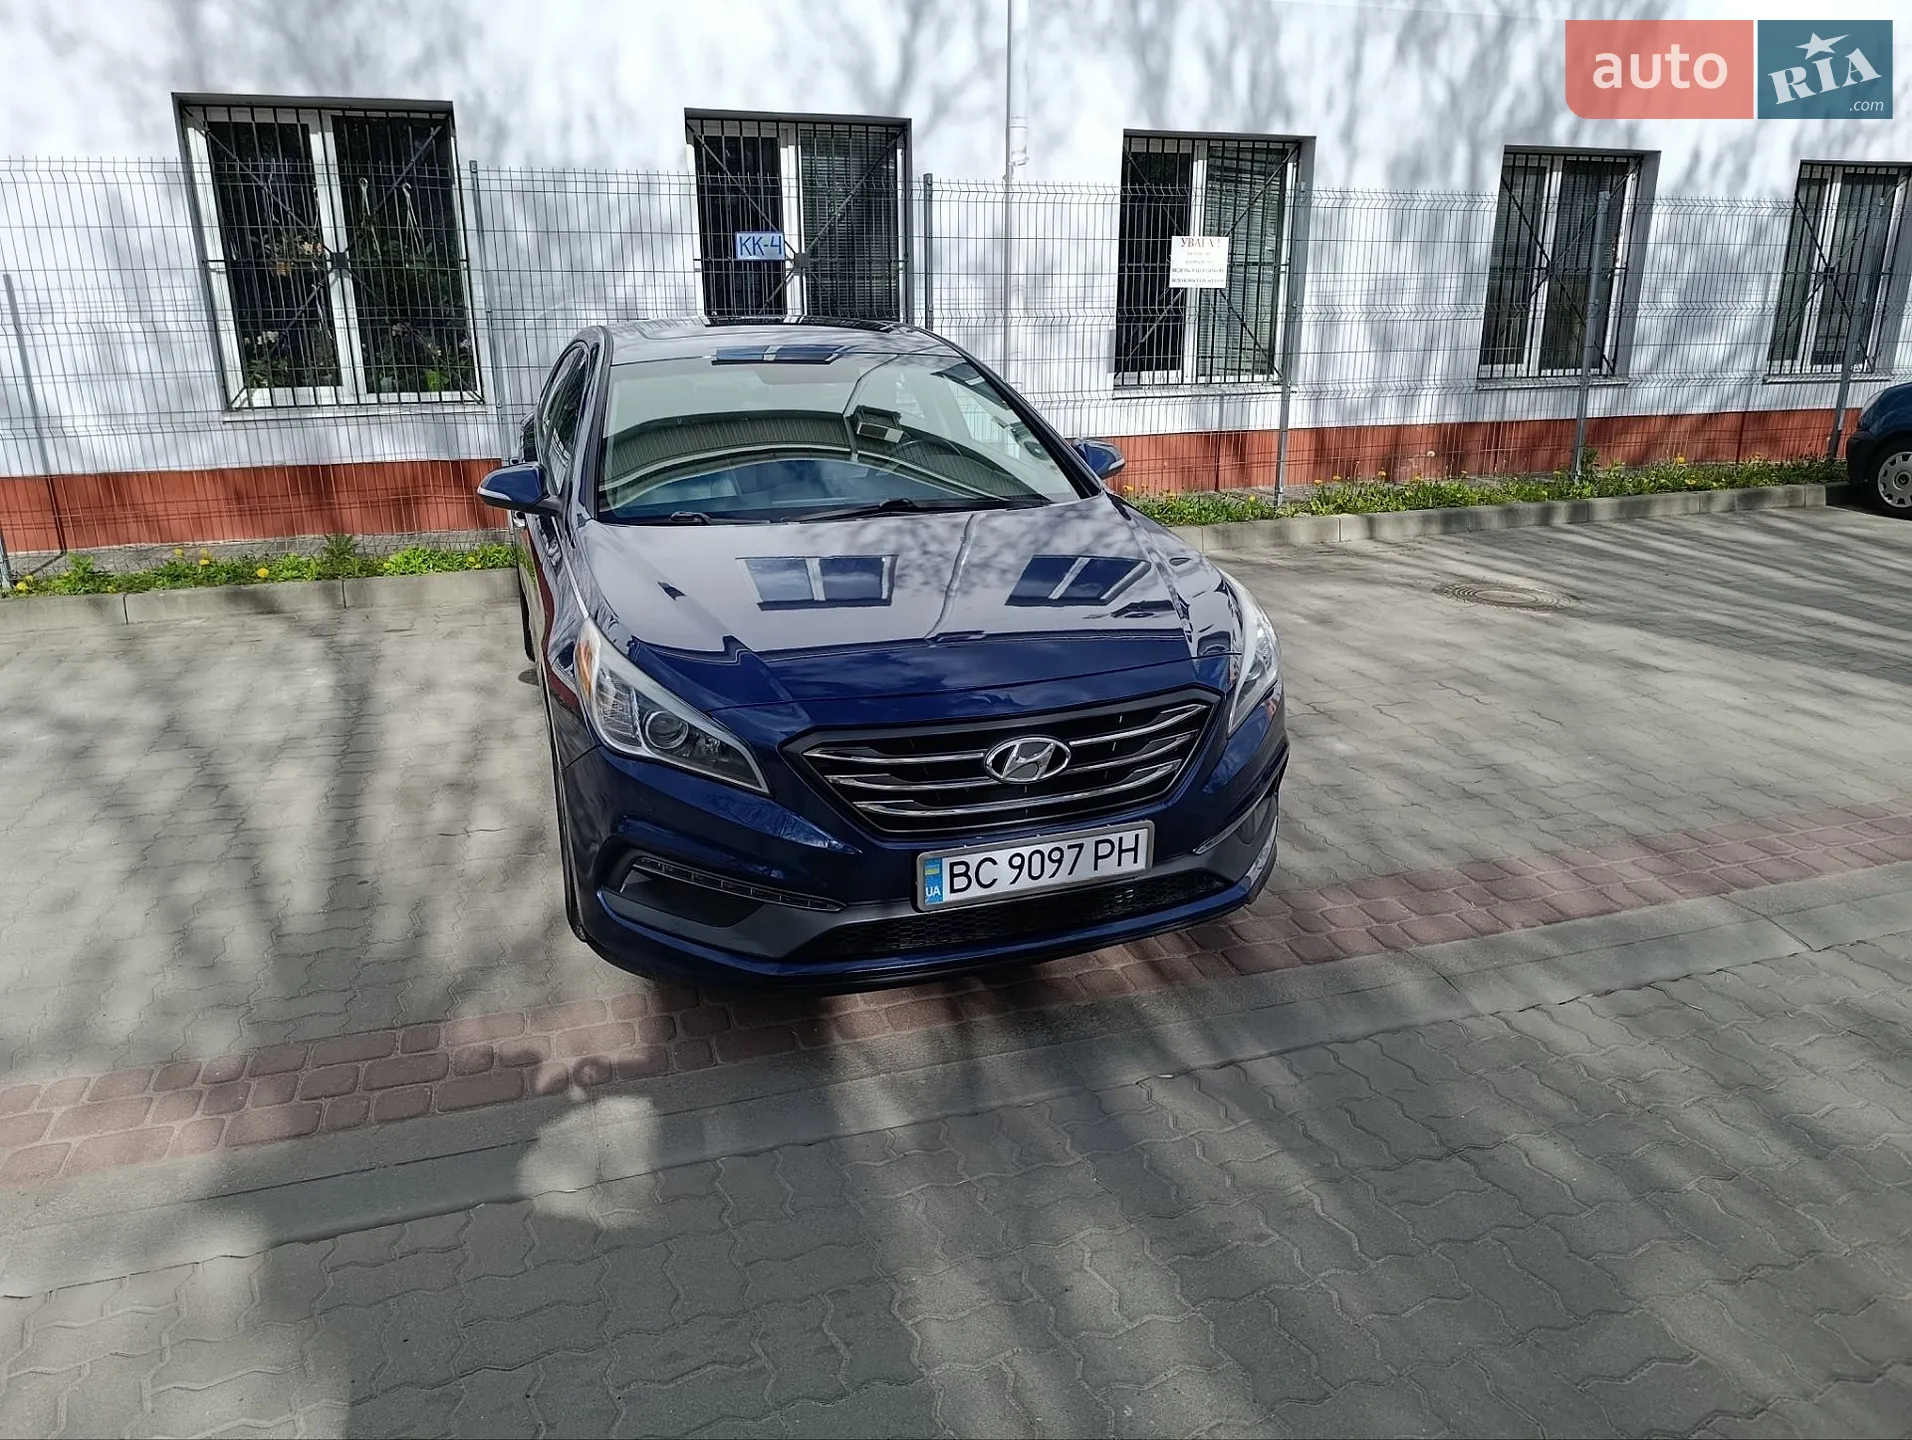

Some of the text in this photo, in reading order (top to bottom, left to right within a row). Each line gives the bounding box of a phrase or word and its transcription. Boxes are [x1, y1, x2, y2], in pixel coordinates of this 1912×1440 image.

[949, 833, 1140, 894] BC 9097 PH
[925, 886, 941, 897] UA
